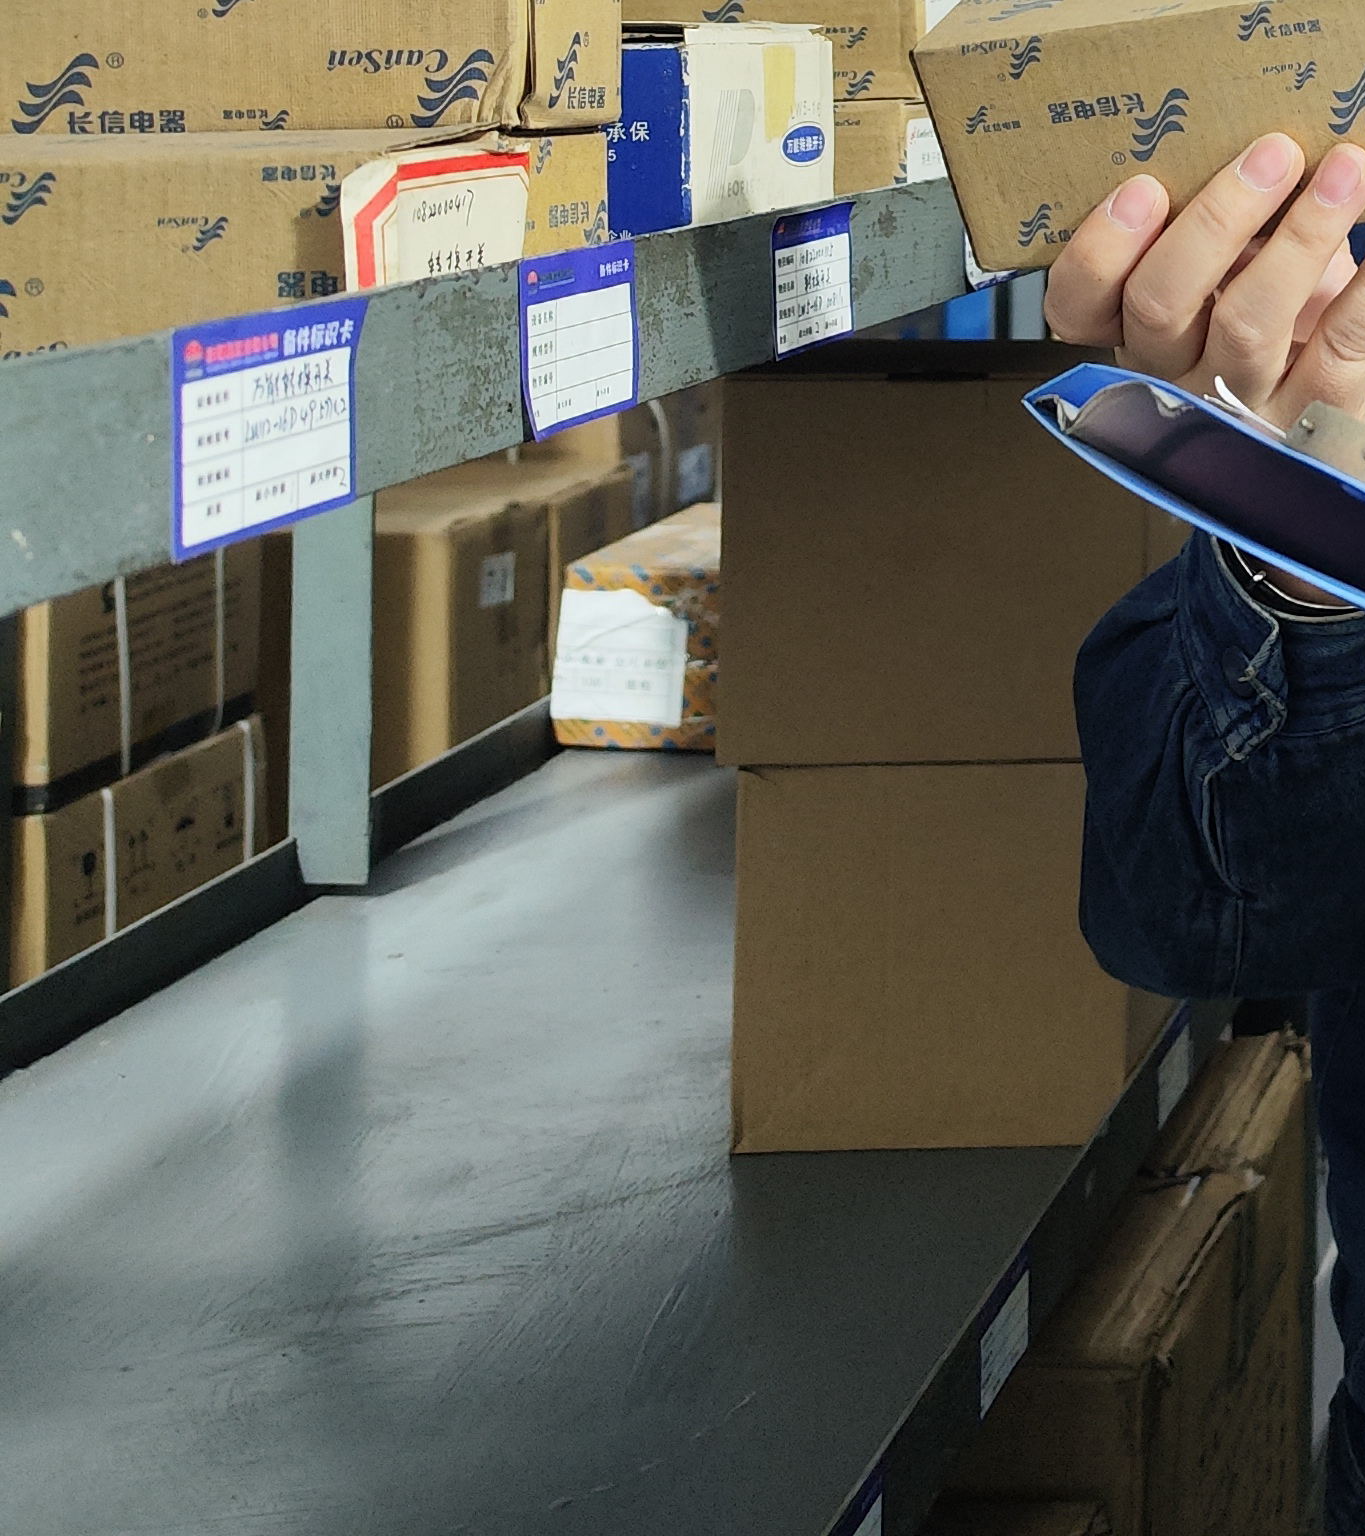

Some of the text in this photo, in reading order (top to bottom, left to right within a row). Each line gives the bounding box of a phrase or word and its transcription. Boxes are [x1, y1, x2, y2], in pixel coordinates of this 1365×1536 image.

[1264, 19, 1322, 39] 长信电器
[327, 48, 449, 73] CanSen
[567, 87, 606, 109] 长信电器
[1047, 92, 1146, 124] 长信电器
[67, 110, 186, 134] 长信电器
[261, 164, 337, 181] 长信电器
